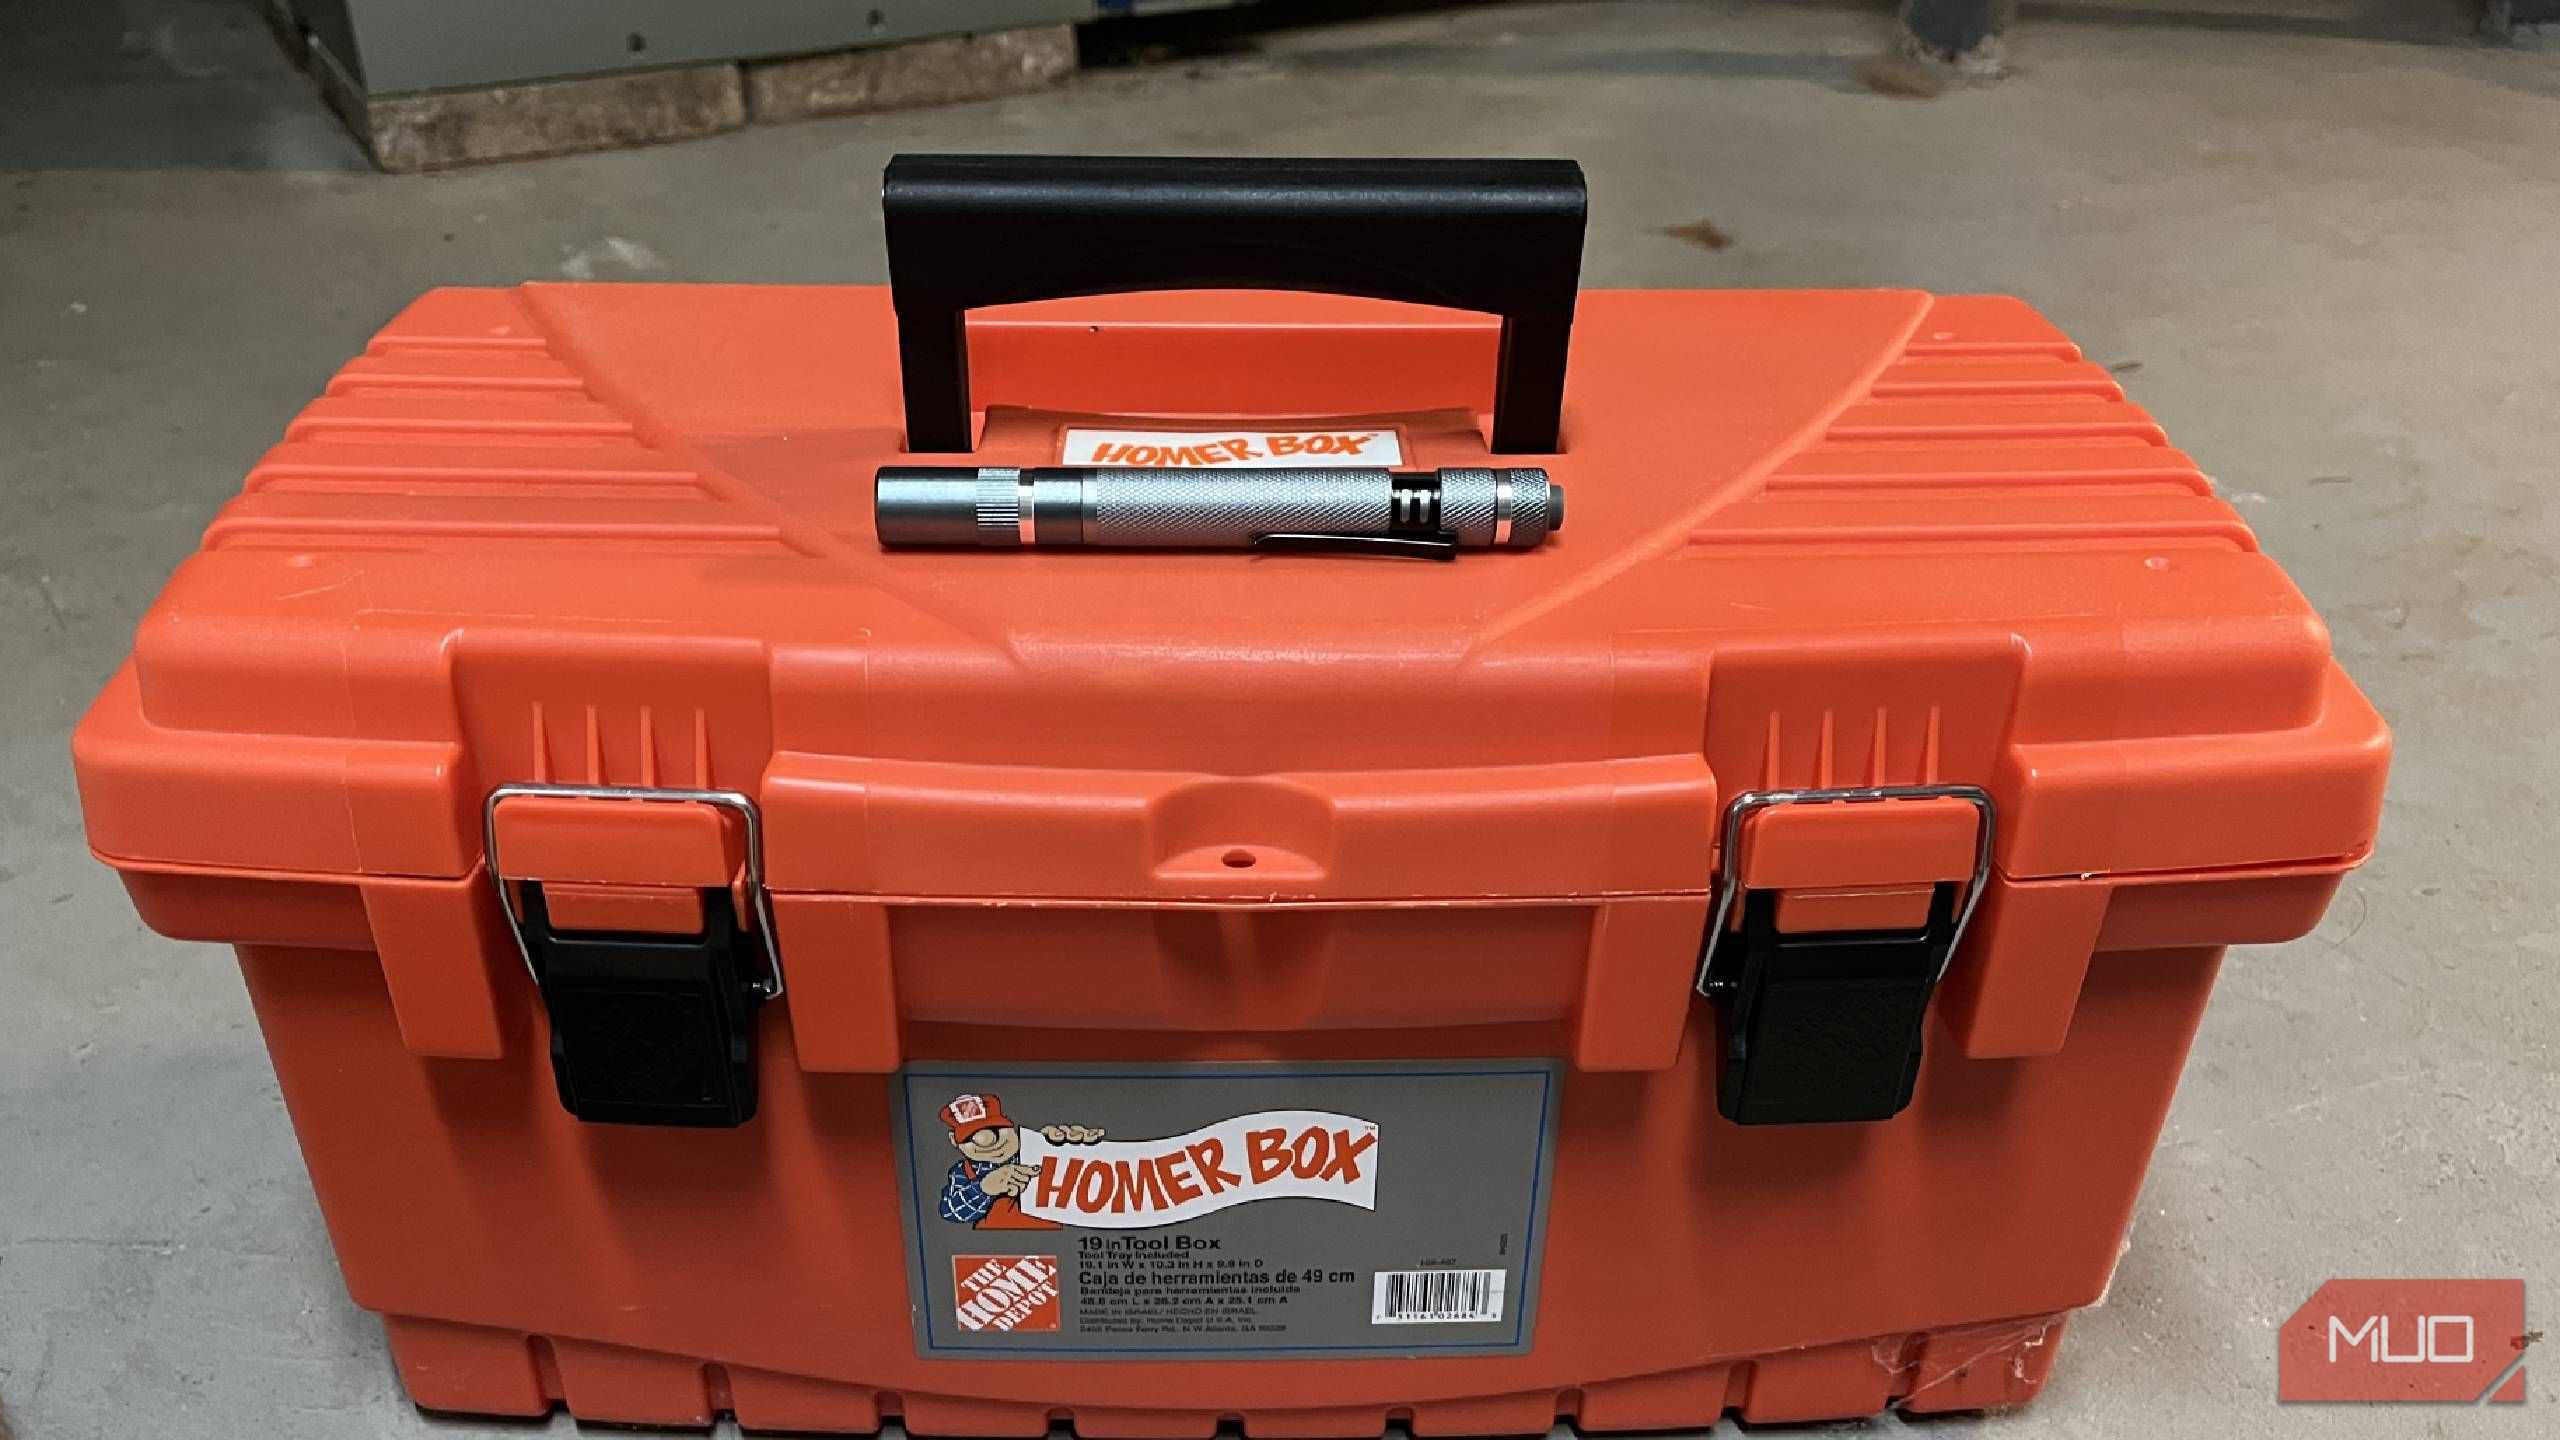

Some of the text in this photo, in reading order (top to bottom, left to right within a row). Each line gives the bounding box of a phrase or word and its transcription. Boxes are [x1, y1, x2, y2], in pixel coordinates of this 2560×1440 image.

[1091, 434, 1372, 466] HOMER BOX
[1035, 1138, 1242, 1214] HOMER
[1246, 1126, 1376, 1184] BOX
[1078, 1236, 1103, 1250] 19
[1176, 1235, 1221, 1250] Box
[1078, 1251, 1189, 1262] Tool Tray Included
[961, 1259, 1007, 1292] THE
[1079, 1269, 1355, 1288] Caja de herramientas de 49 cm
[957, 1256, 1056, 1330] HOME
[993, 1282, 1058, 1331] DEPOT
[1133, 1287, 1162, 1297] para
